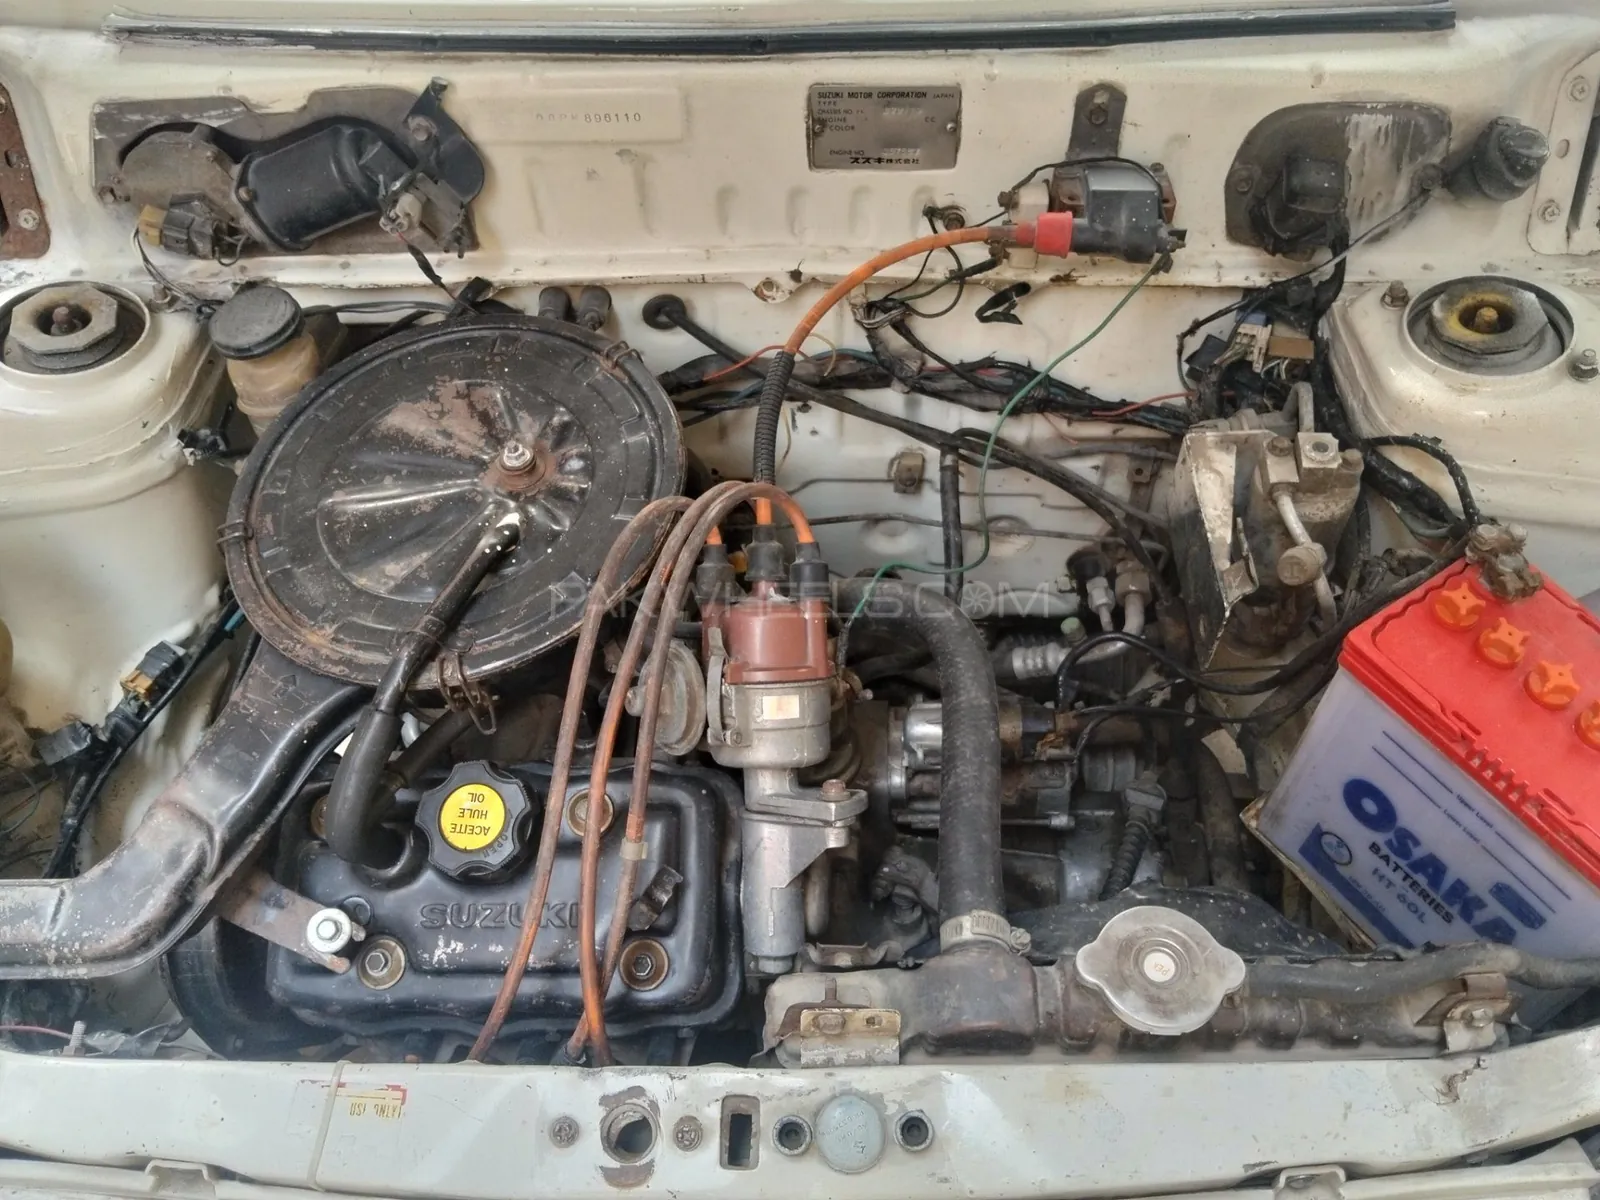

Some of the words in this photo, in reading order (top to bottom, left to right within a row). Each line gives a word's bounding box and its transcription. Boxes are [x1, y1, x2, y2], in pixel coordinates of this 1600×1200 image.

[877, 91, 927, 99] CORPORATION
[468, 792, 485, 803] OIL
[458, 807, 488, 819] HULE
[450, 822, 491, 836] ACEITE
[1343, 778, 1517, 945] OSAKA
[1369, 841, 1454, 924] BATTERIES
